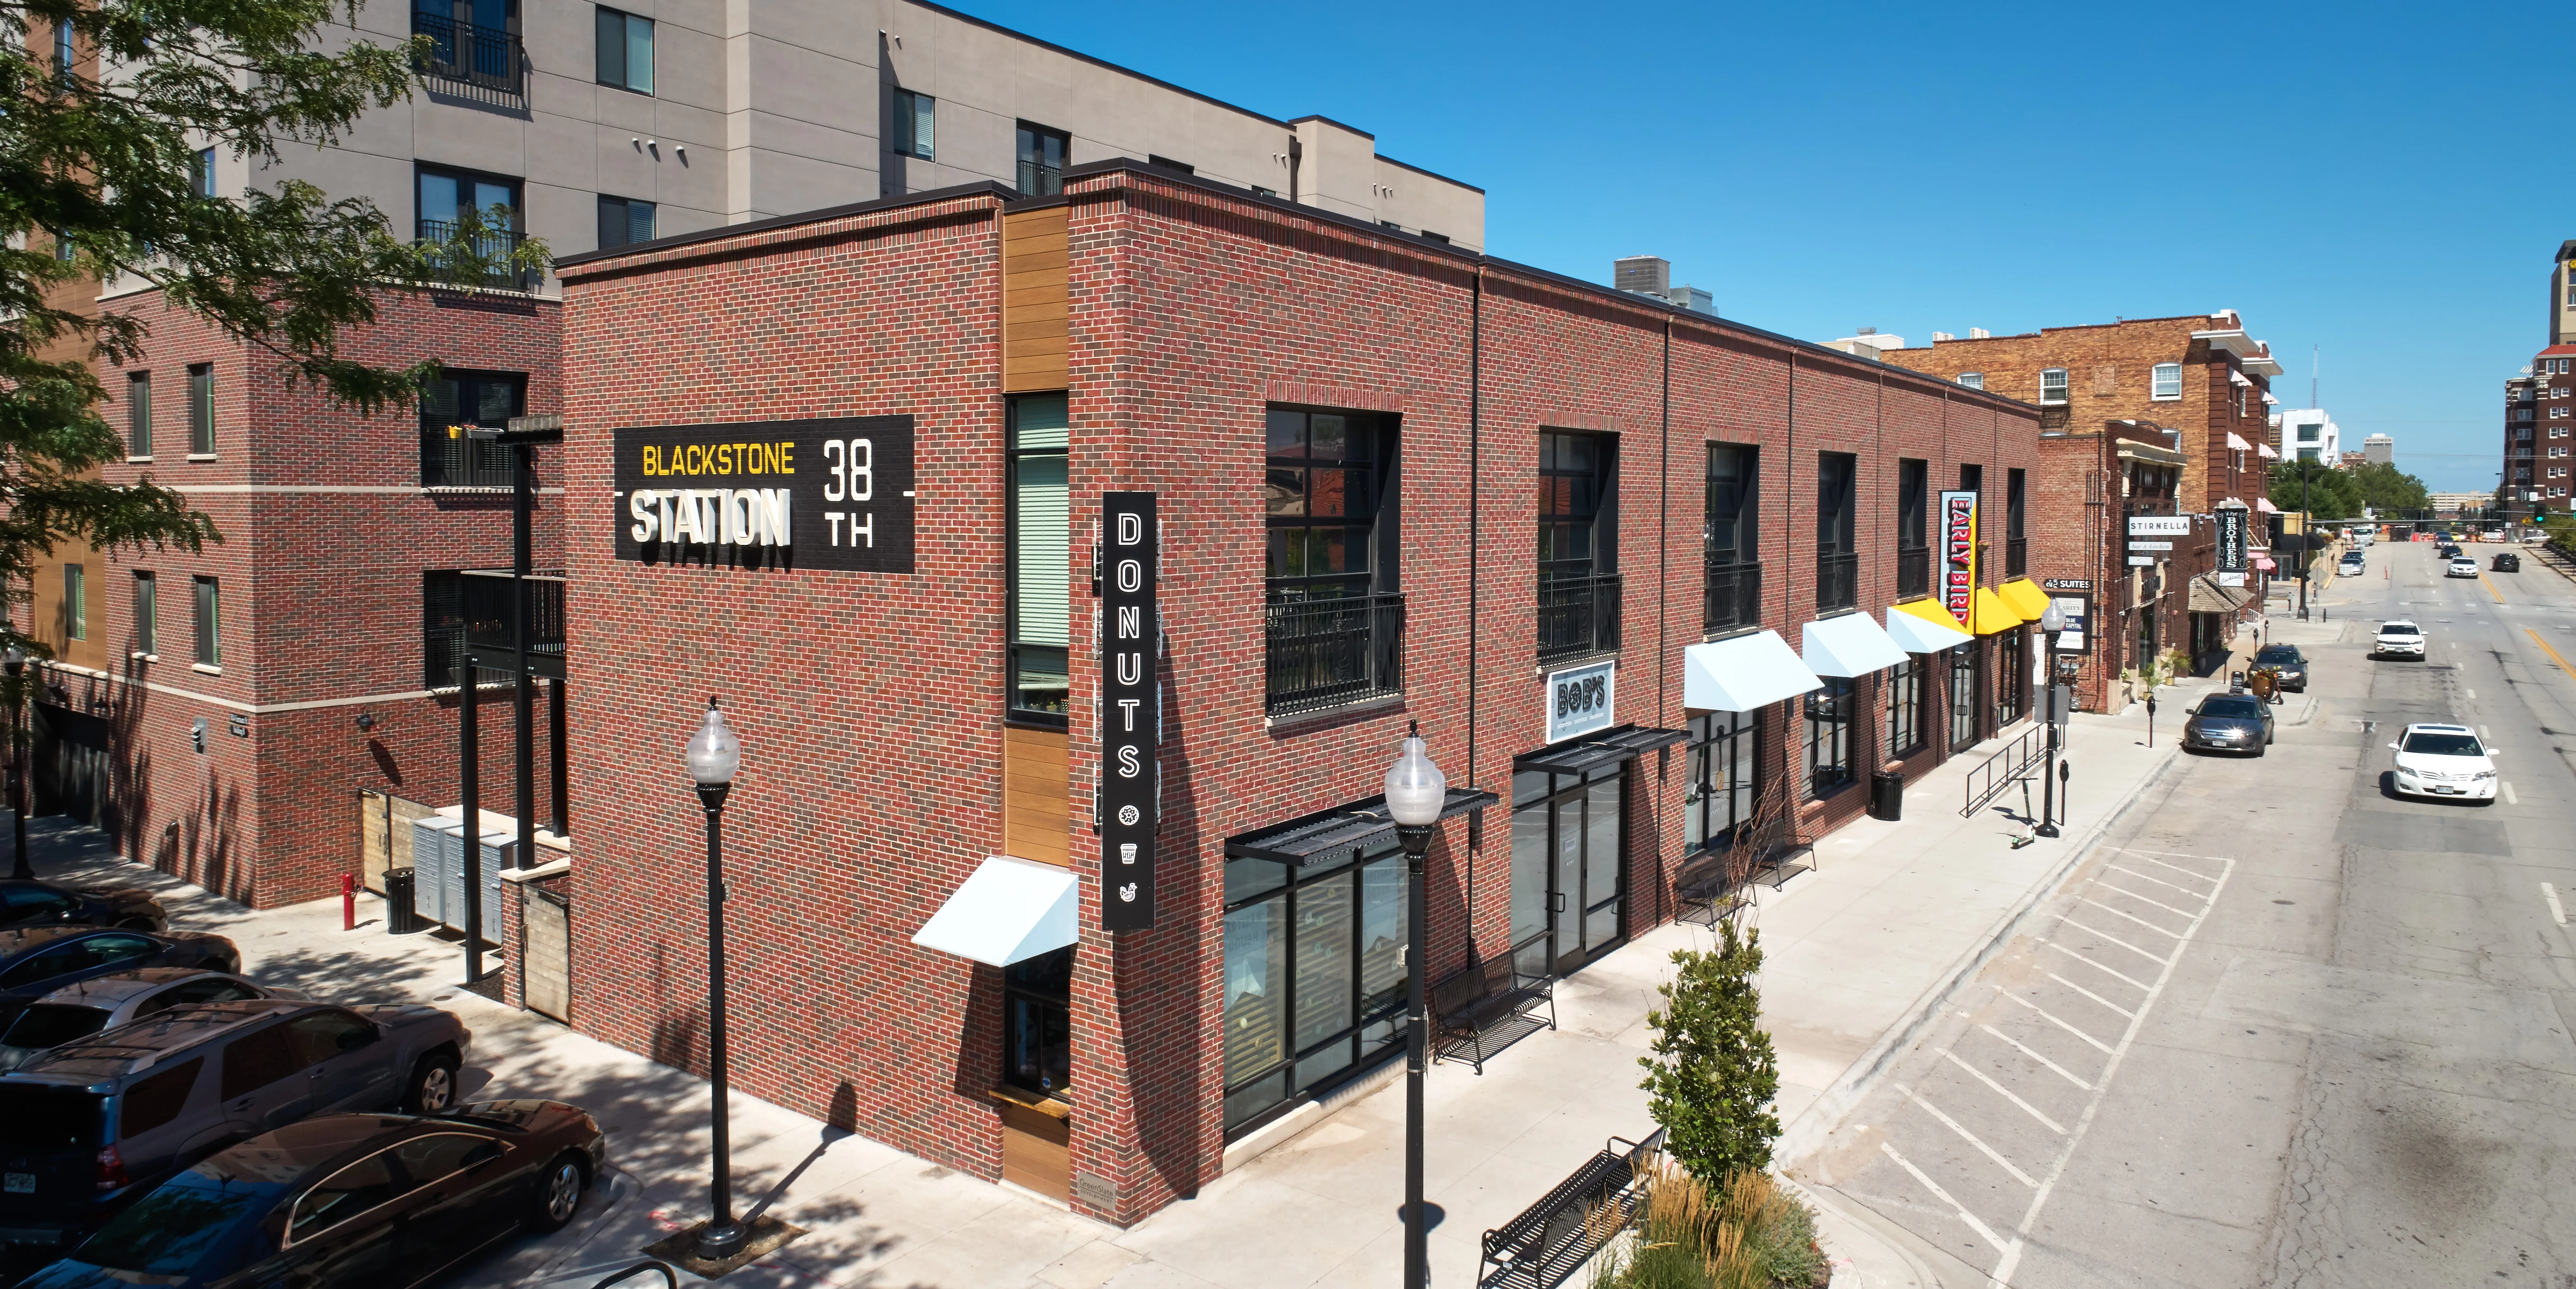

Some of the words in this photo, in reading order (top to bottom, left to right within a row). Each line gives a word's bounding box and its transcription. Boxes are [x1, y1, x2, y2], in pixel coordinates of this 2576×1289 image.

[643, 442, 795, 476] BLACKSTONE
[824, 438, 872, 501] 38
[630, 489, 791, 547] STATION
[824, 512, 873, 548] TH
[1951, 496, 1972, 566] EARLY
[2226, 517, 2238, 568] BROTHERS
[1950, 570, 1970, 625] BIRD
[1117, 513, 1142, 778] DONUTS
[1558, 675, 1605, 716] BOB'S
[1557, 721, 1572, 729] DONUTS
[1229, 931, 1258, 952] DOUGH
[1079, 1178, 1113, 1197] GreenSlate
[1080, 1188, 1112, 1204] DEVELOPMENT
